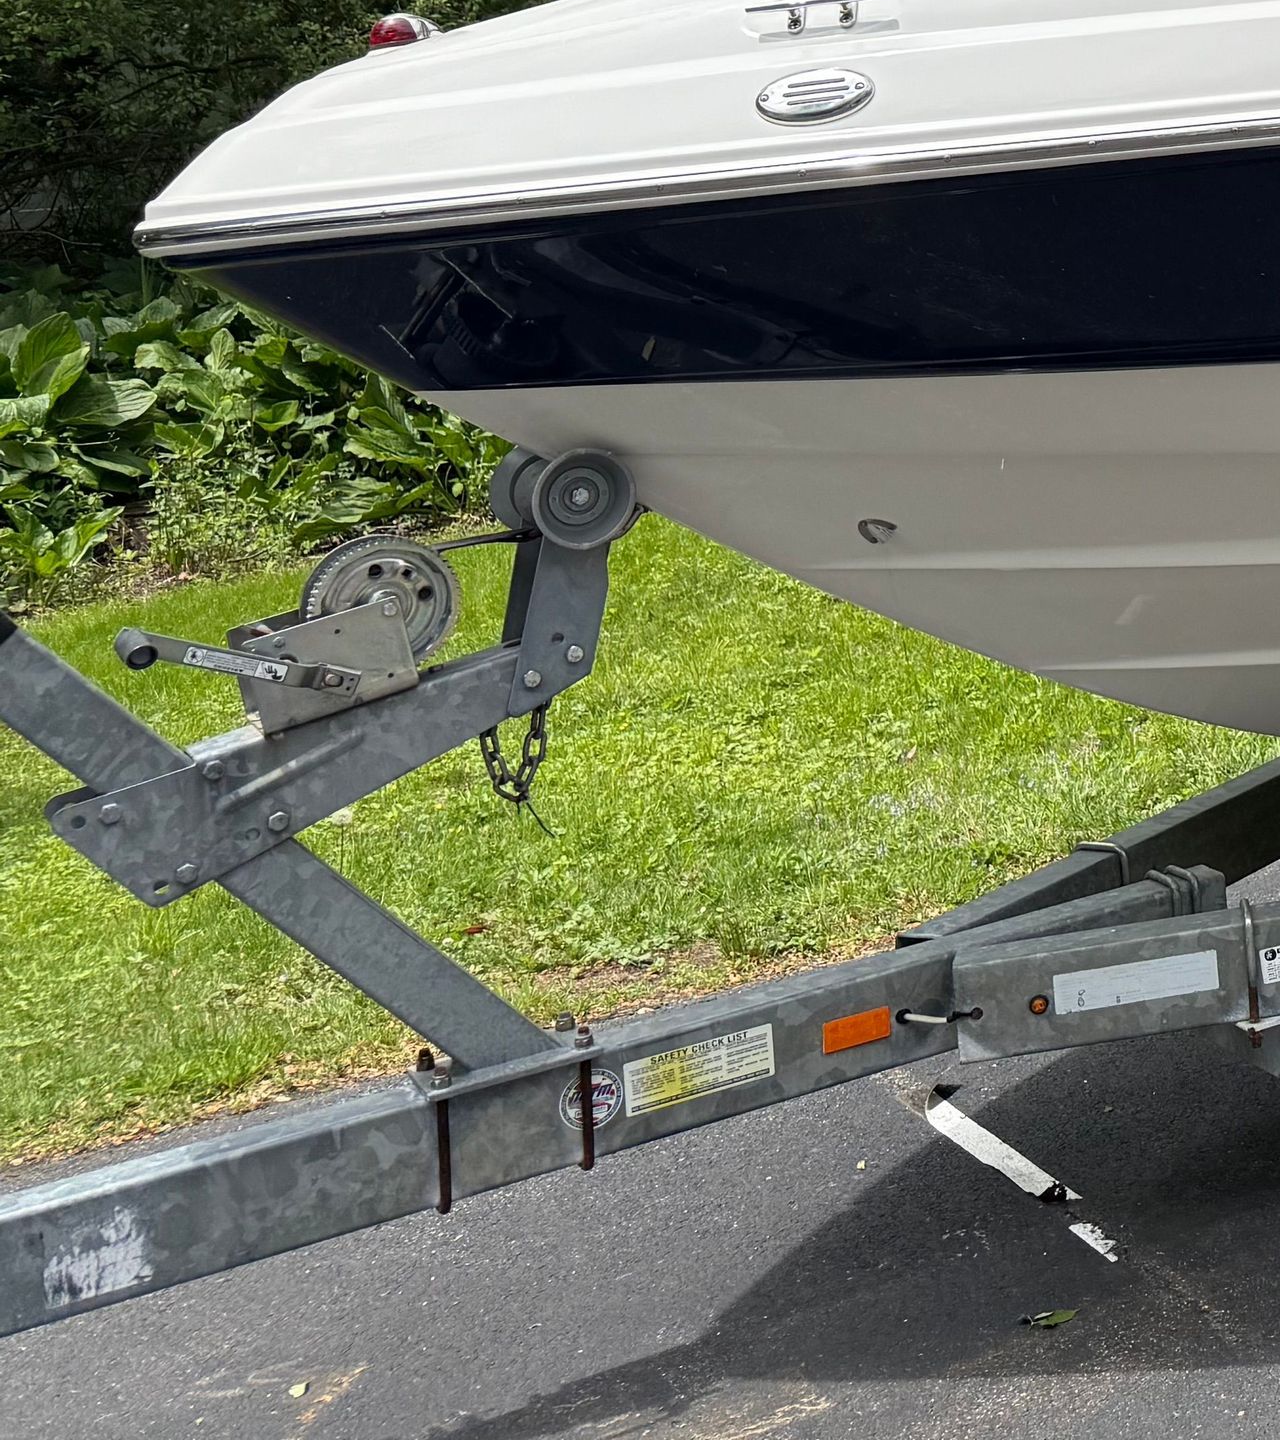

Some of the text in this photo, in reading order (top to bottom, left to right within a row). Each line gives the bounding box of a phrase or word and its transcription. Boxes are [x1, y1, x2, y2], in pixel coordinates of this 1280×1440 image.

[650, 1031, 749, 1064] SAFETY CHECK LIST
